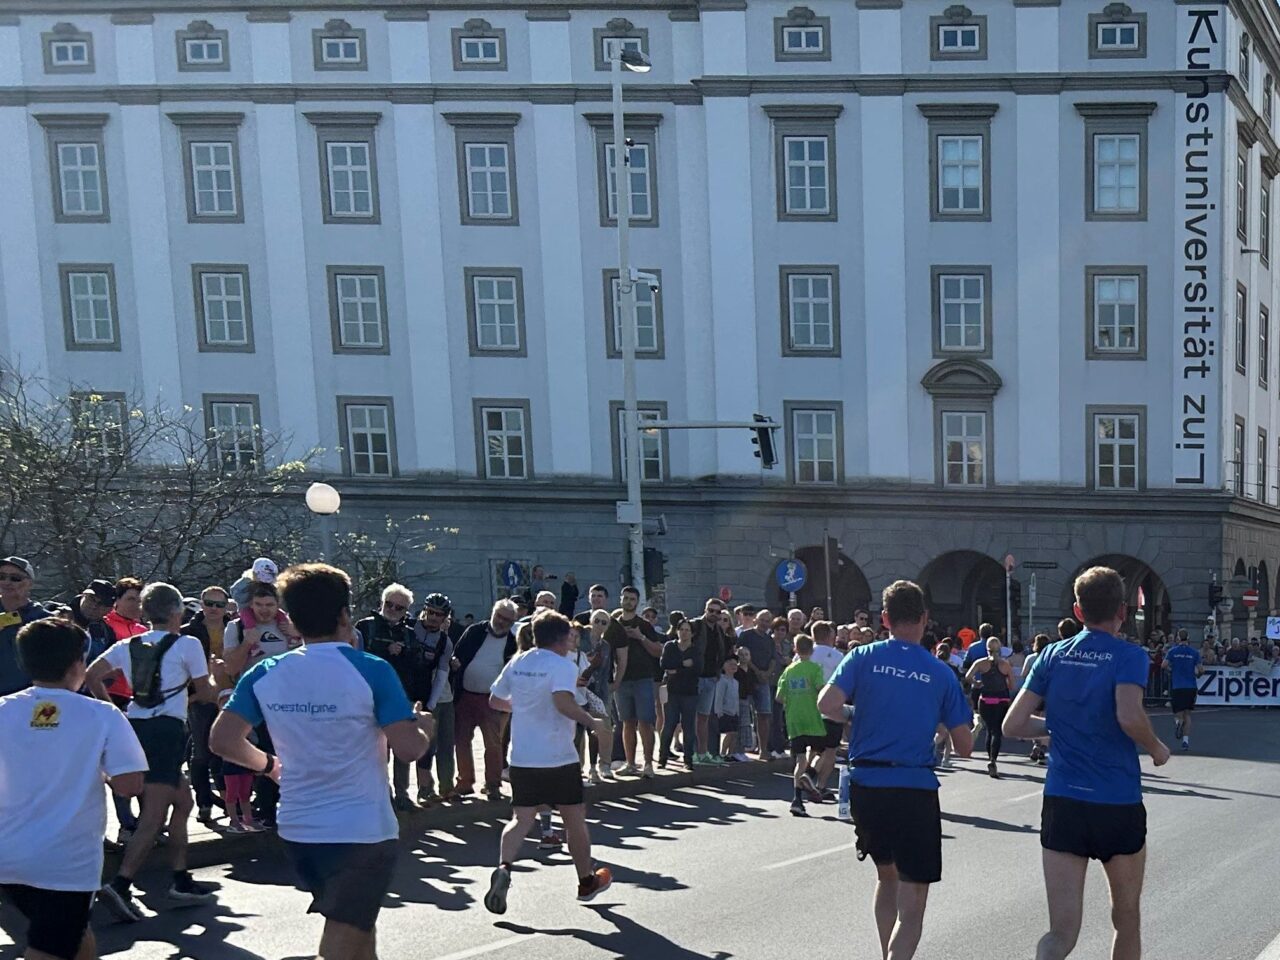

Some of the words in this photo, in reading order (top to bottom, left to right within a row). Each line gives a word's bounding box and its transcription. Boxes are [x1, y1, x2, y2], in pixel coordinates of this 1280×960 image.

[1183, 10, 1218, 379] Kunstuniversität
[1175, 394, 1206, 484] Linz
[1053, 649, 1112, 661] OCHACHER
[908, 671, 931, 683] AG
[266, 702, 337, 715] voestalpine
